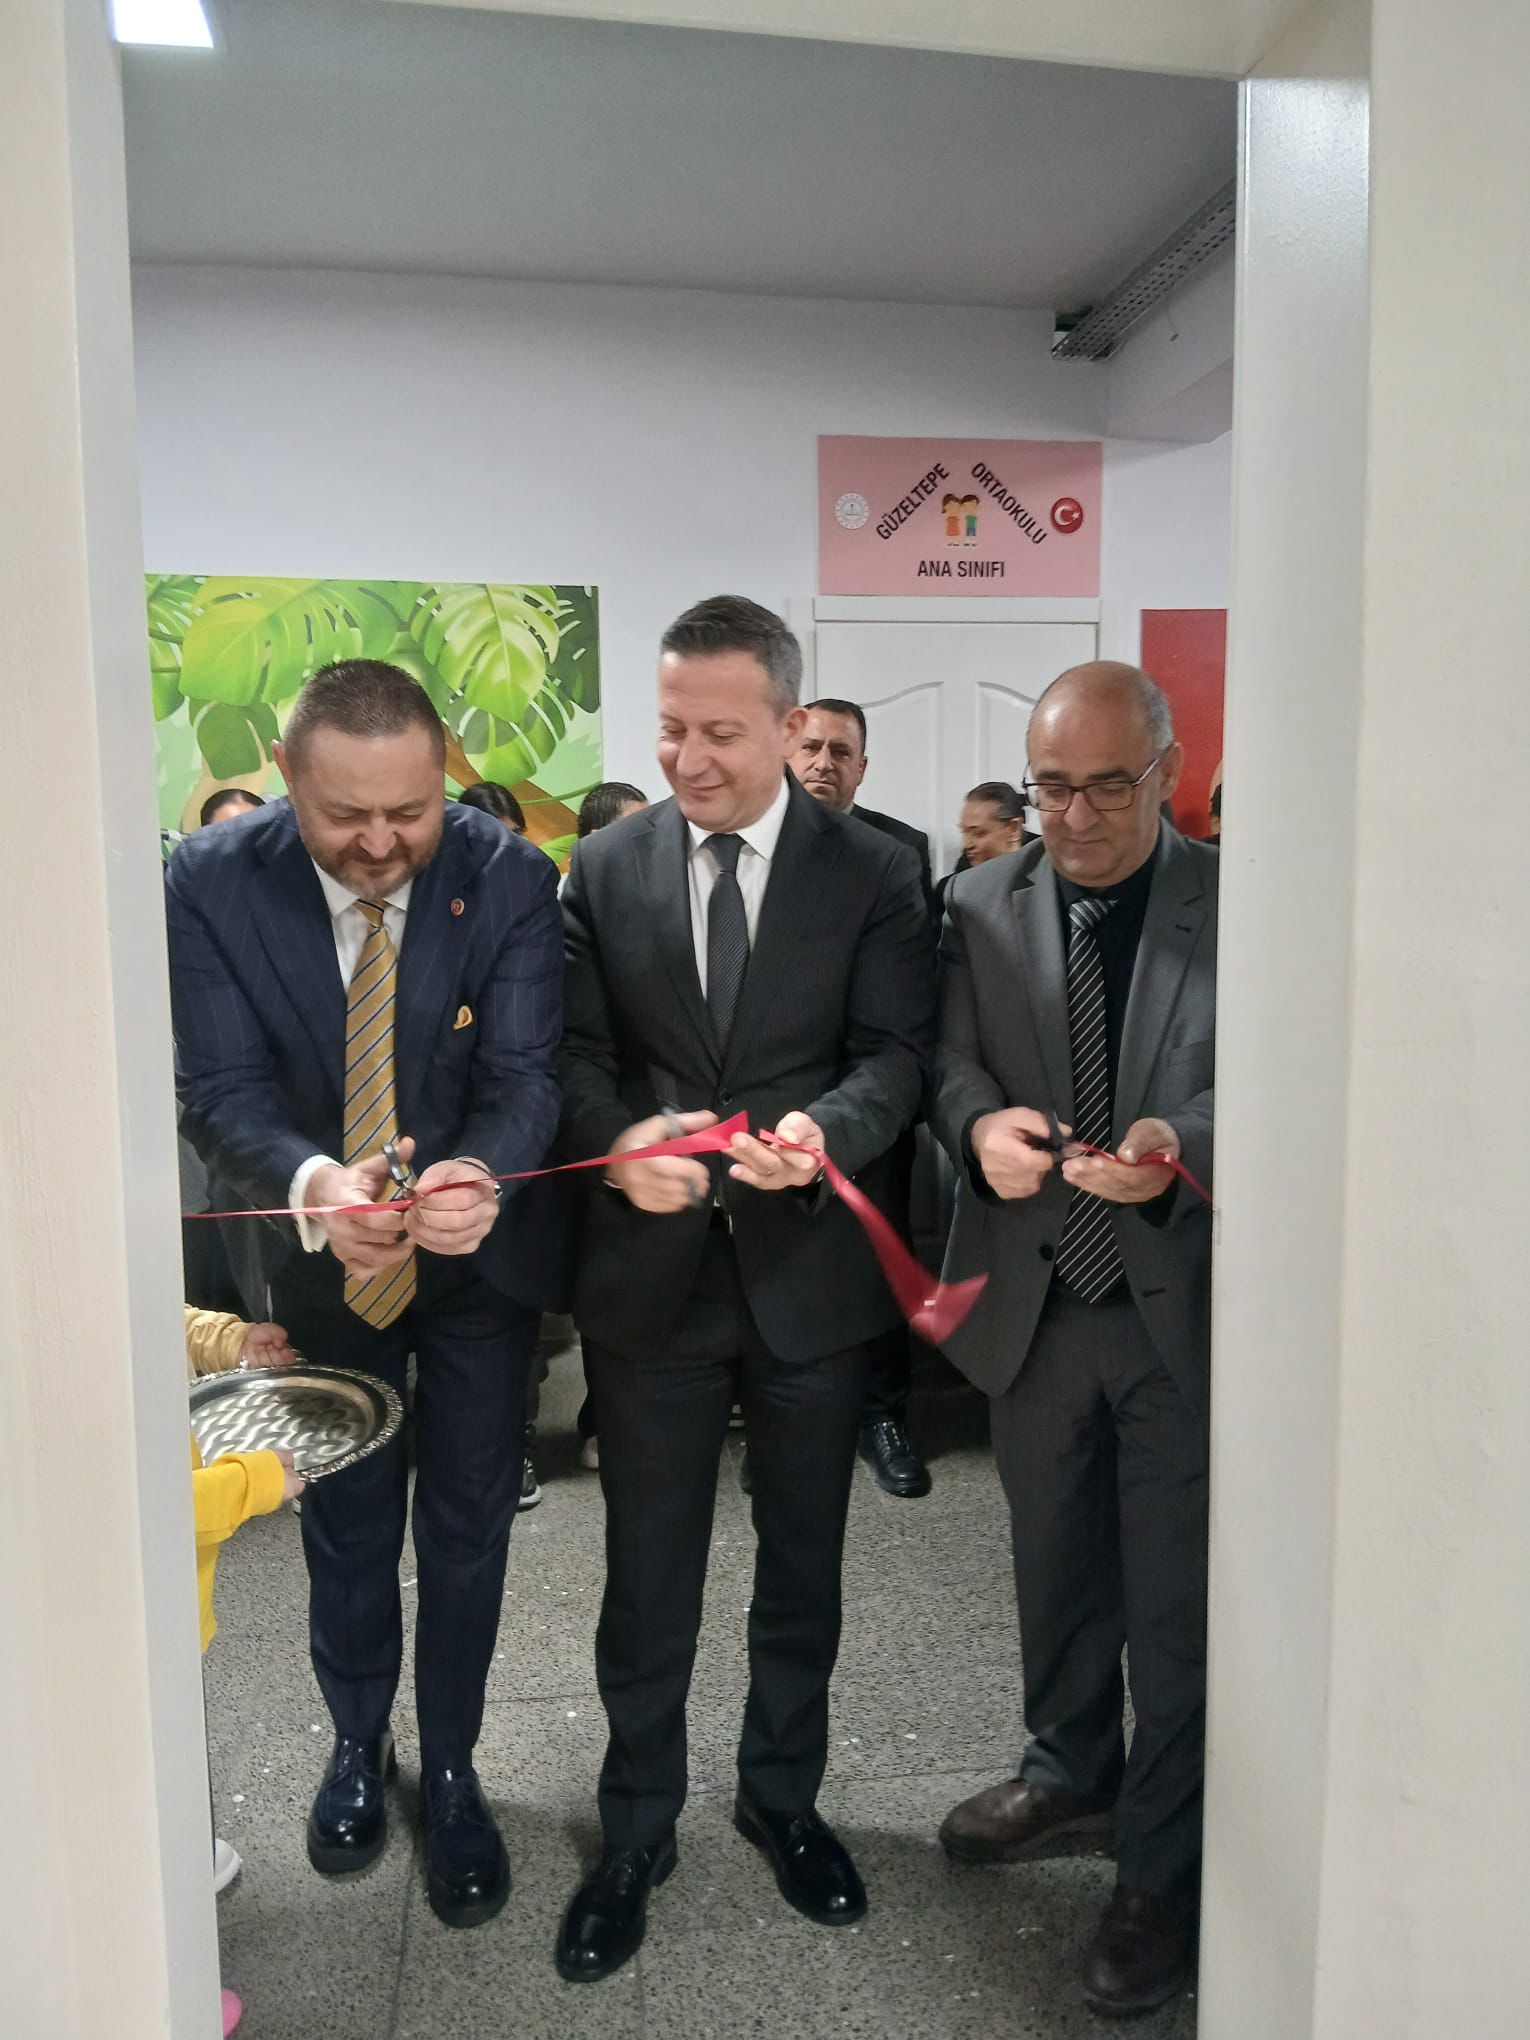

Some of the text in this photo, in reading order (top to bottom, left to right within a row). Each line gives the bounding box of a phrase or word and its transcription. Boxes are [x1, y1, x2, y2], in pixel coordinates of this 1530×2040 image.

[876, 462, 1048, 545] GÜZELTEPE ORTAOKULU
[917, 560, 1005, 578] ANA SINIFI
